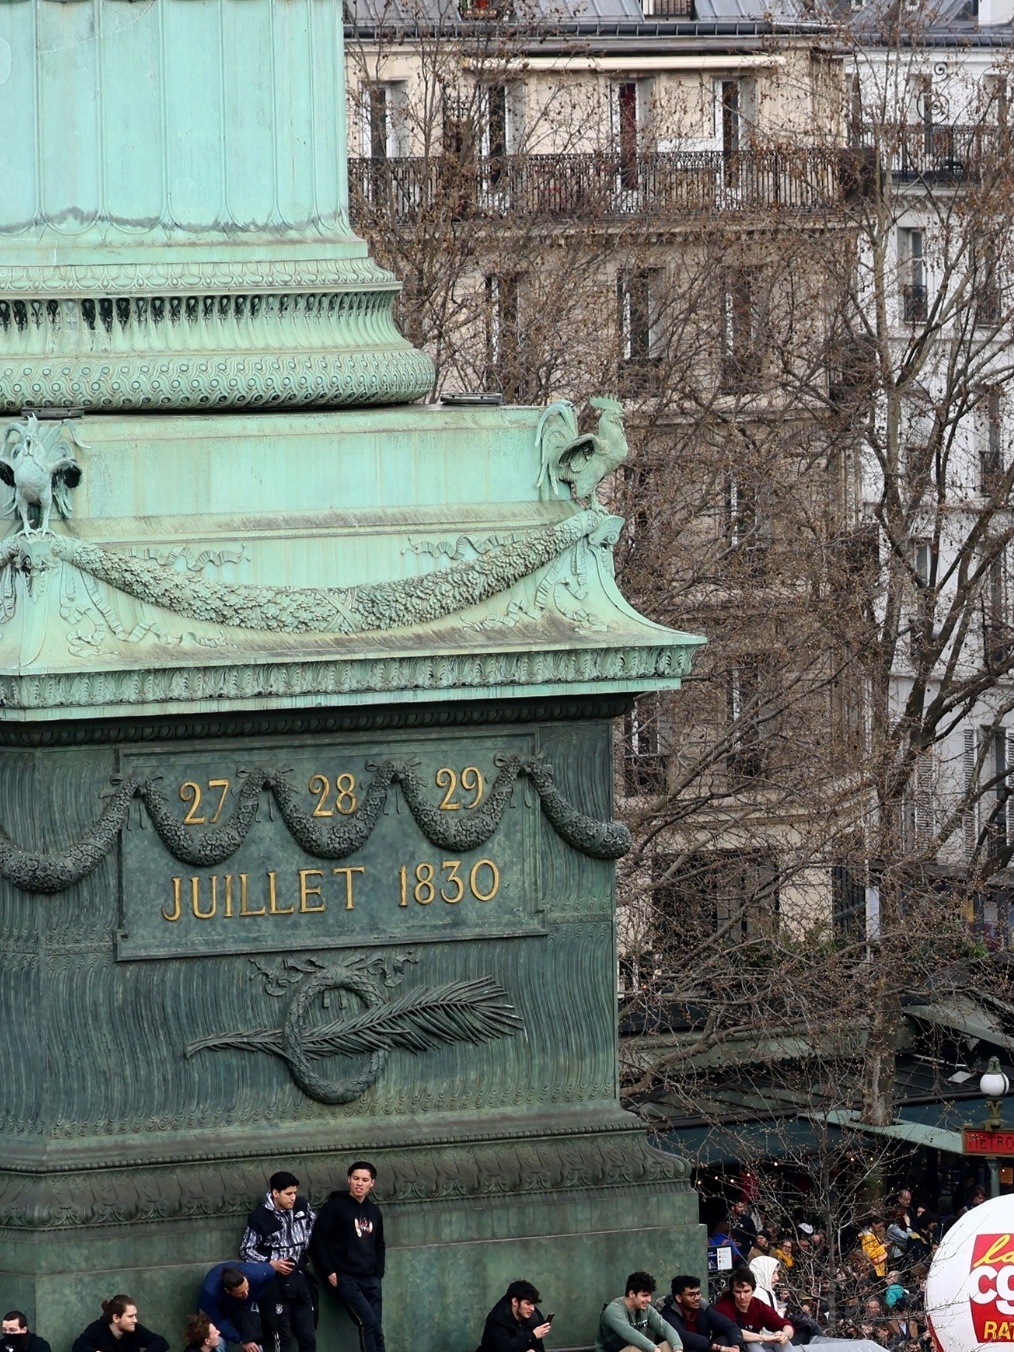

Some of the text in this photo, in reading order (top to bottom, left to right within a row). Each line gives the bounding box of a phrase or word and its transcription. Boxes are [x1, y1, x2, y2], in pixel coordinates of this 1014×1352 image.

[179, 766, 484, 825] 27 28 29
[163, 860, 501, 922] JUILLET 1830
